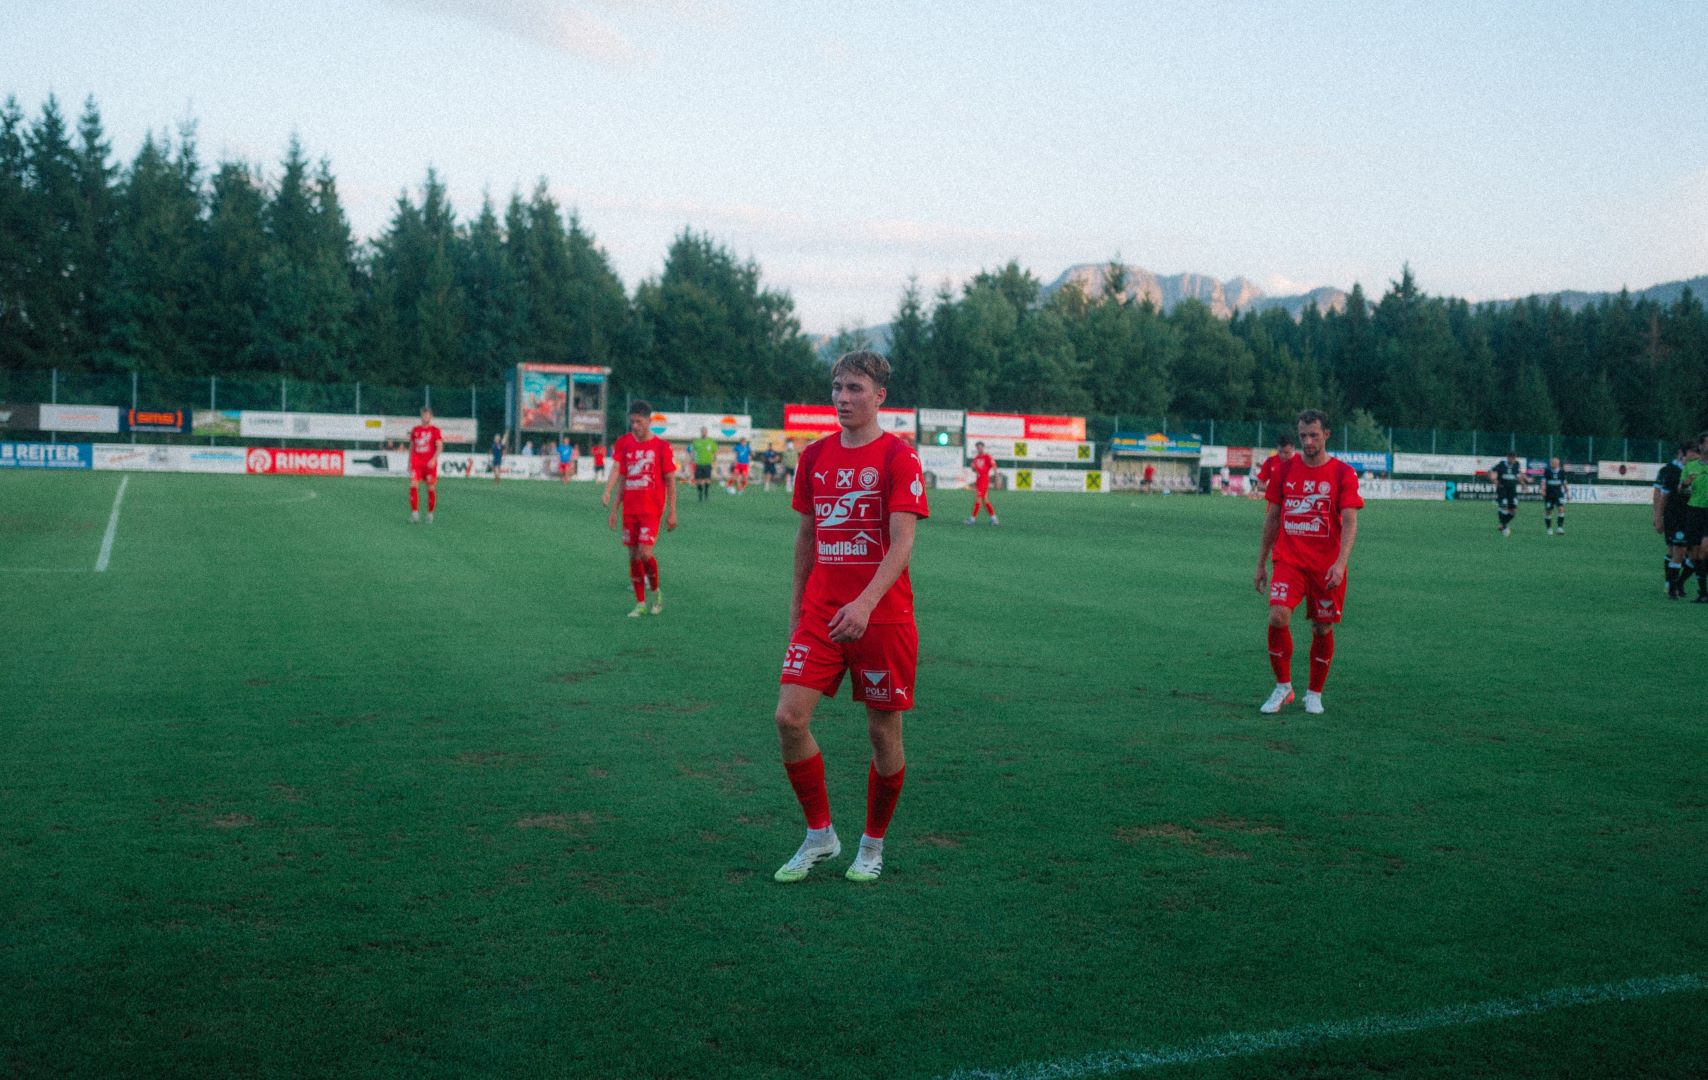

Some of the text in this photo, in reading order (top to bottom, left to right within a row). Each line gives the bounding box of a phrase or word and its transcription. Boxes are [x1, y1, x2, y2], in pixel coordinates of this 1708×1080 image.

[16, 444, 79, 461] REITER
[275, 452, 341, 470] RINGER
[865, 686, 888, 697] POLZ
